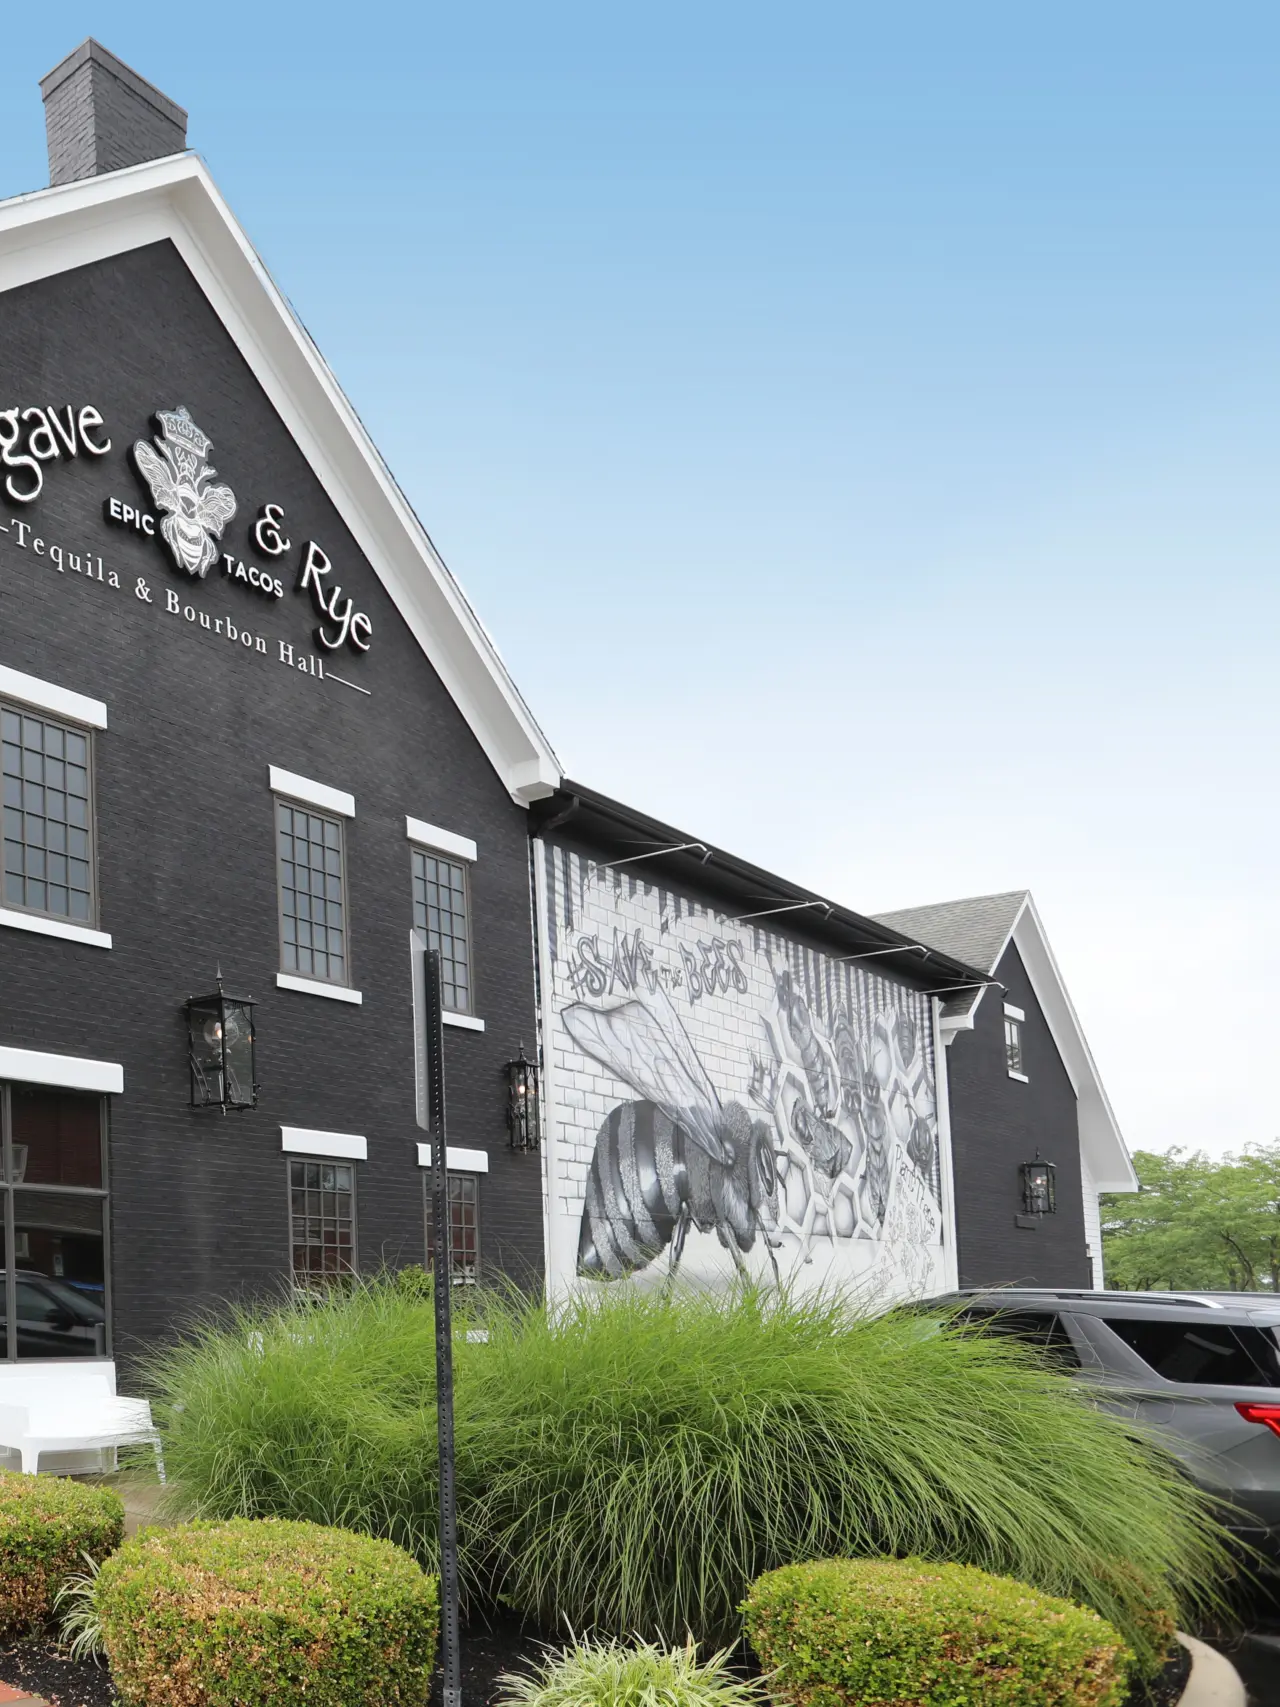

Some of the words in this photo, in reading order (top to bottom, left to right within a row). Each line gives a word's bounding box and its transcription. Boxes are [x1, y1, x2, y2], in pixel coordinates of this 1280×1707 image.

[11, 518, 121, 590] Tequila
[134, 577, 153, 603] &
[165, 588, 268, 655] Bourbon
[278, 639, 325, 681] Hall
[109, 496, 155, 536] EPIC
[223, 553, 284, 598] TACOS
[255, 503, 291, 555] &
[300, 540, 373, 651] Rye
[678, 937, 748, 1007] BEES
